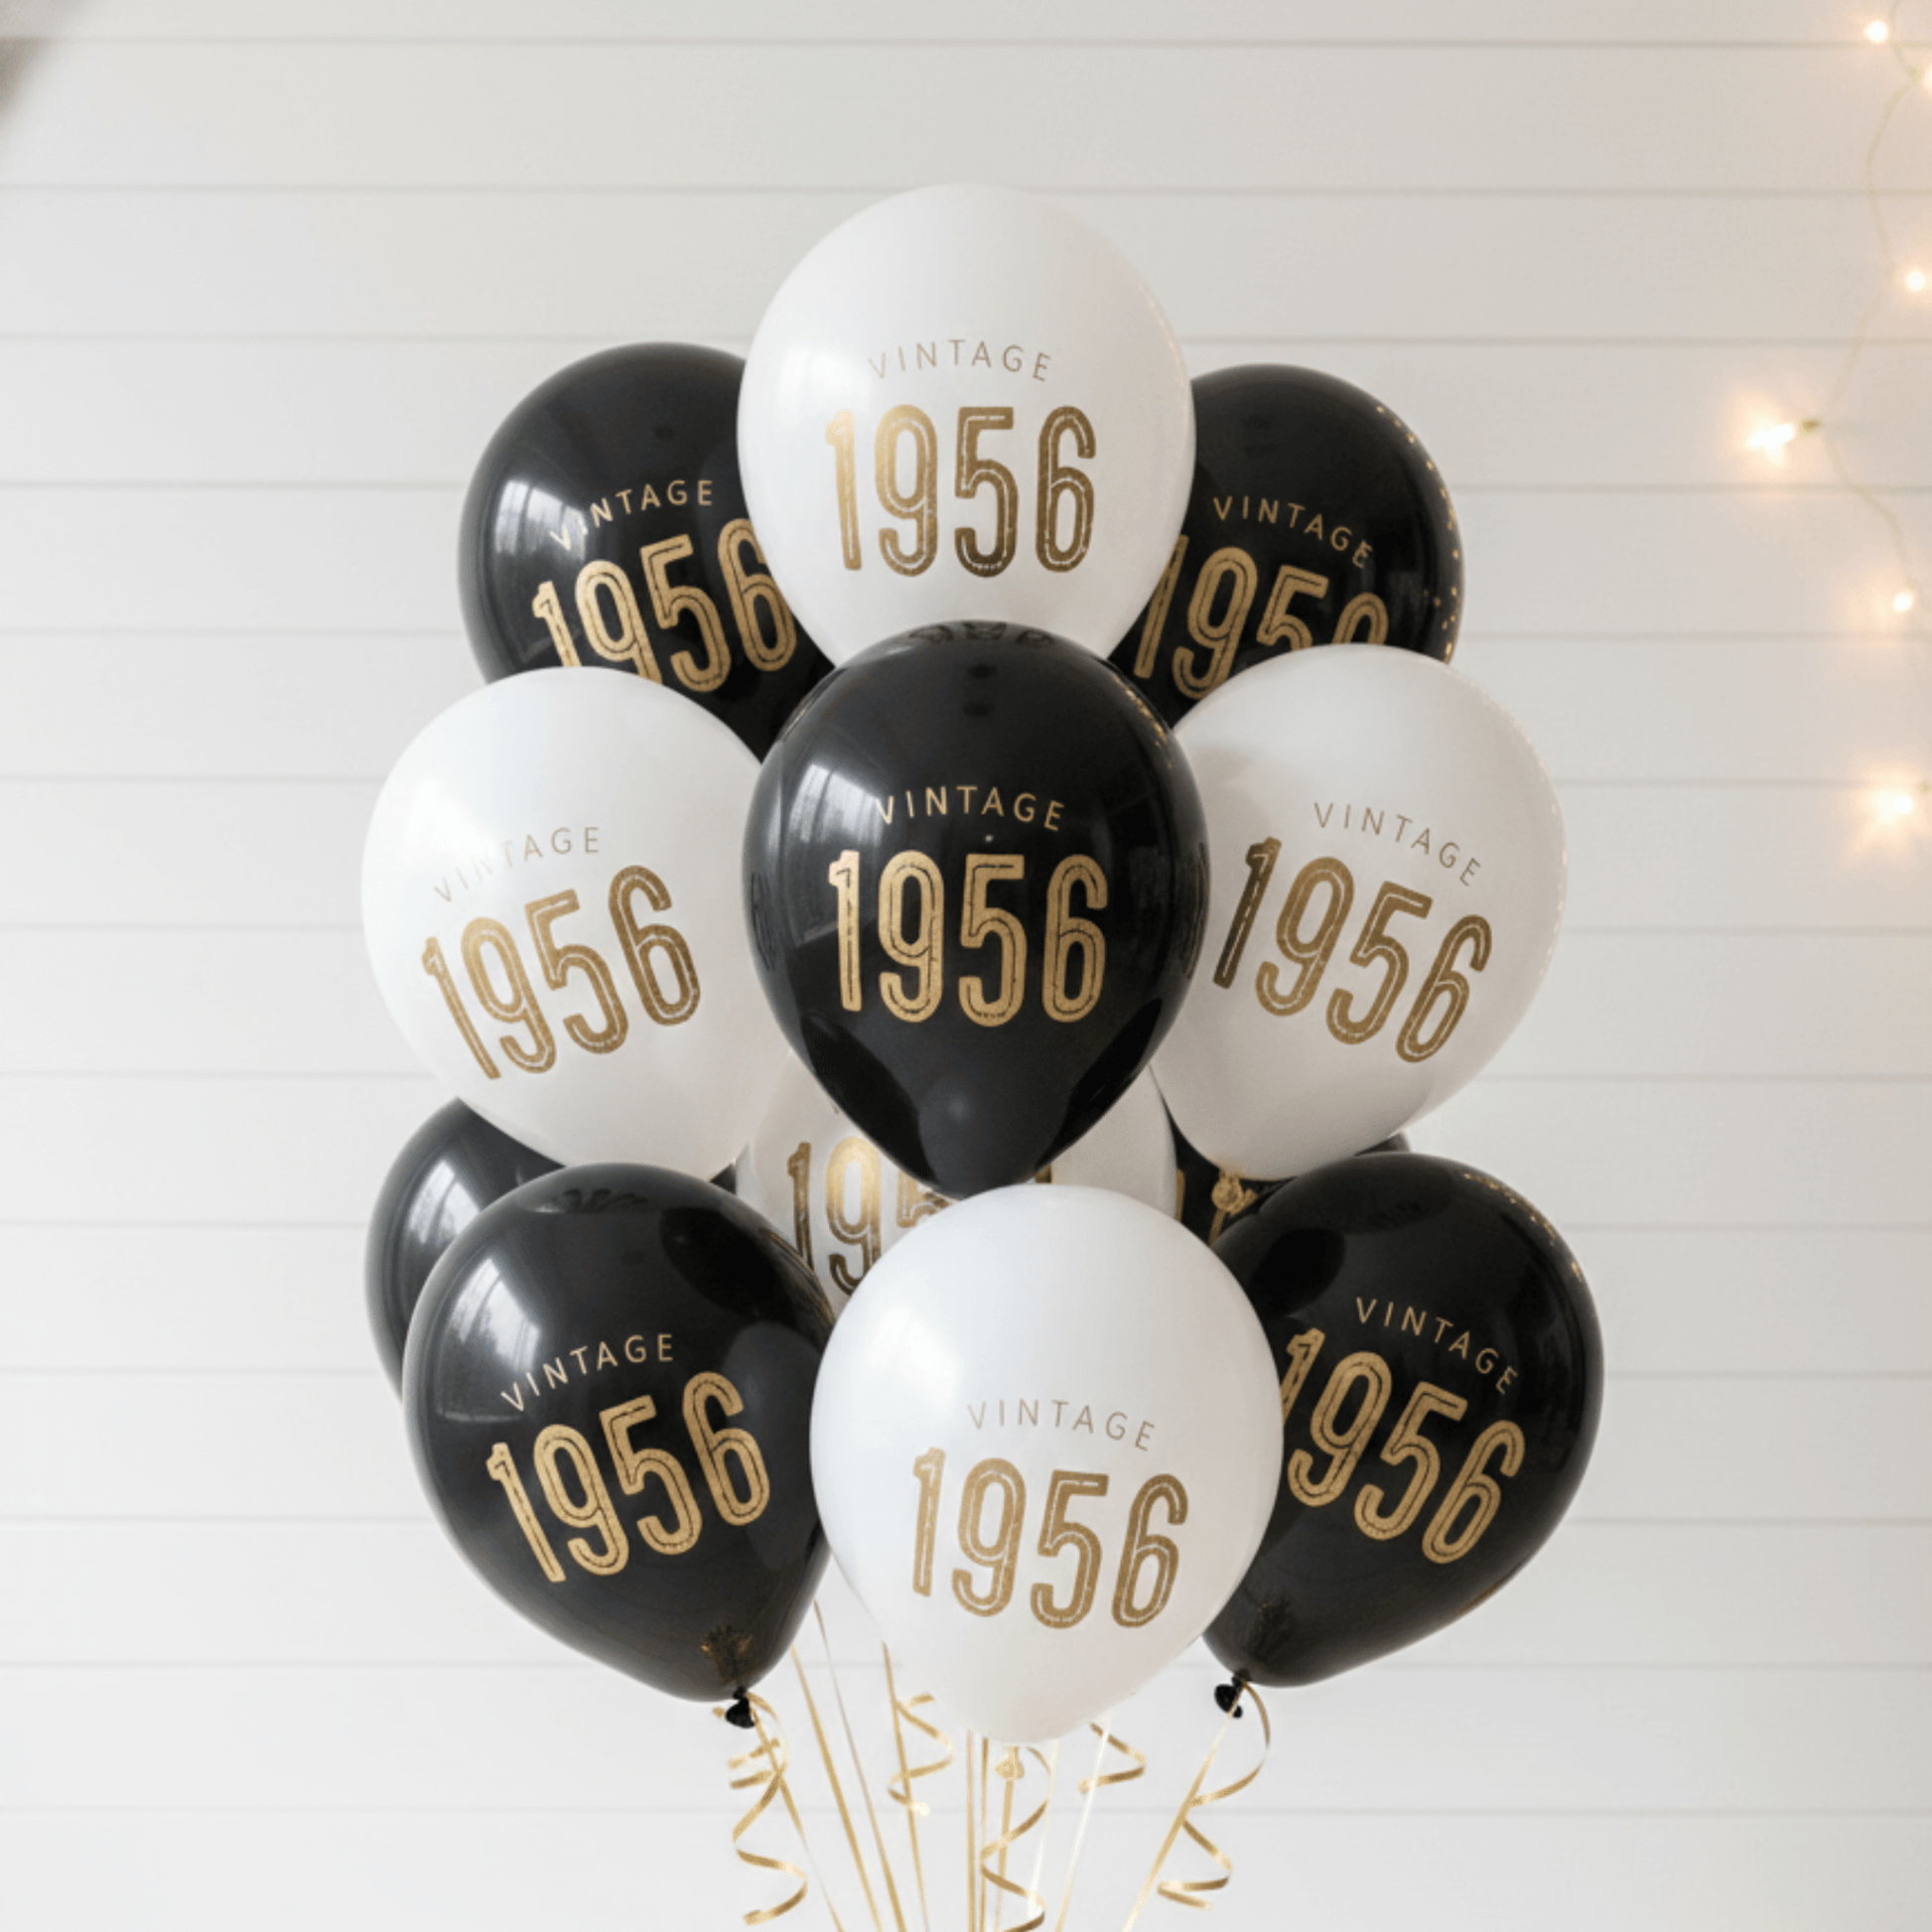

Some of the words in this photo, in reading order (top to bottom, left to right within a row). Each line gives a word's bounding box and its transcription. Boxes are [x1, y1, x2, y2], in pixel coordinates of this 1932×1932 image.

[869, 340, 1051, 382] VINTAGE
[548, 480, 713, 552] VINTAGE
[825, 404, 1096, 578] 1956
[1213, 496, 1373, 568] VINTAGE
[532, 518, 797, 693] 1956
[875, 785, 1064, 831] VINTAGE
[1313, 801, 1481, 887] VINTAGE
[421, 865, 701, 1080] 1956
[828, 850, 1108, 1028] 1956
[1213, 836, 1492, 1063] 1956
[500, 1333, 674, 1413] VINTAGE
[1356, 1296, 1519, 1395] VINTAGE
[485, 1371, 770, 1583] 1956
[967, 1398, 1155, 1452] VINTAGE
[1280, 1327, 1526, 1565] 1956
[912, 1447, 1189, 1629] 1956
